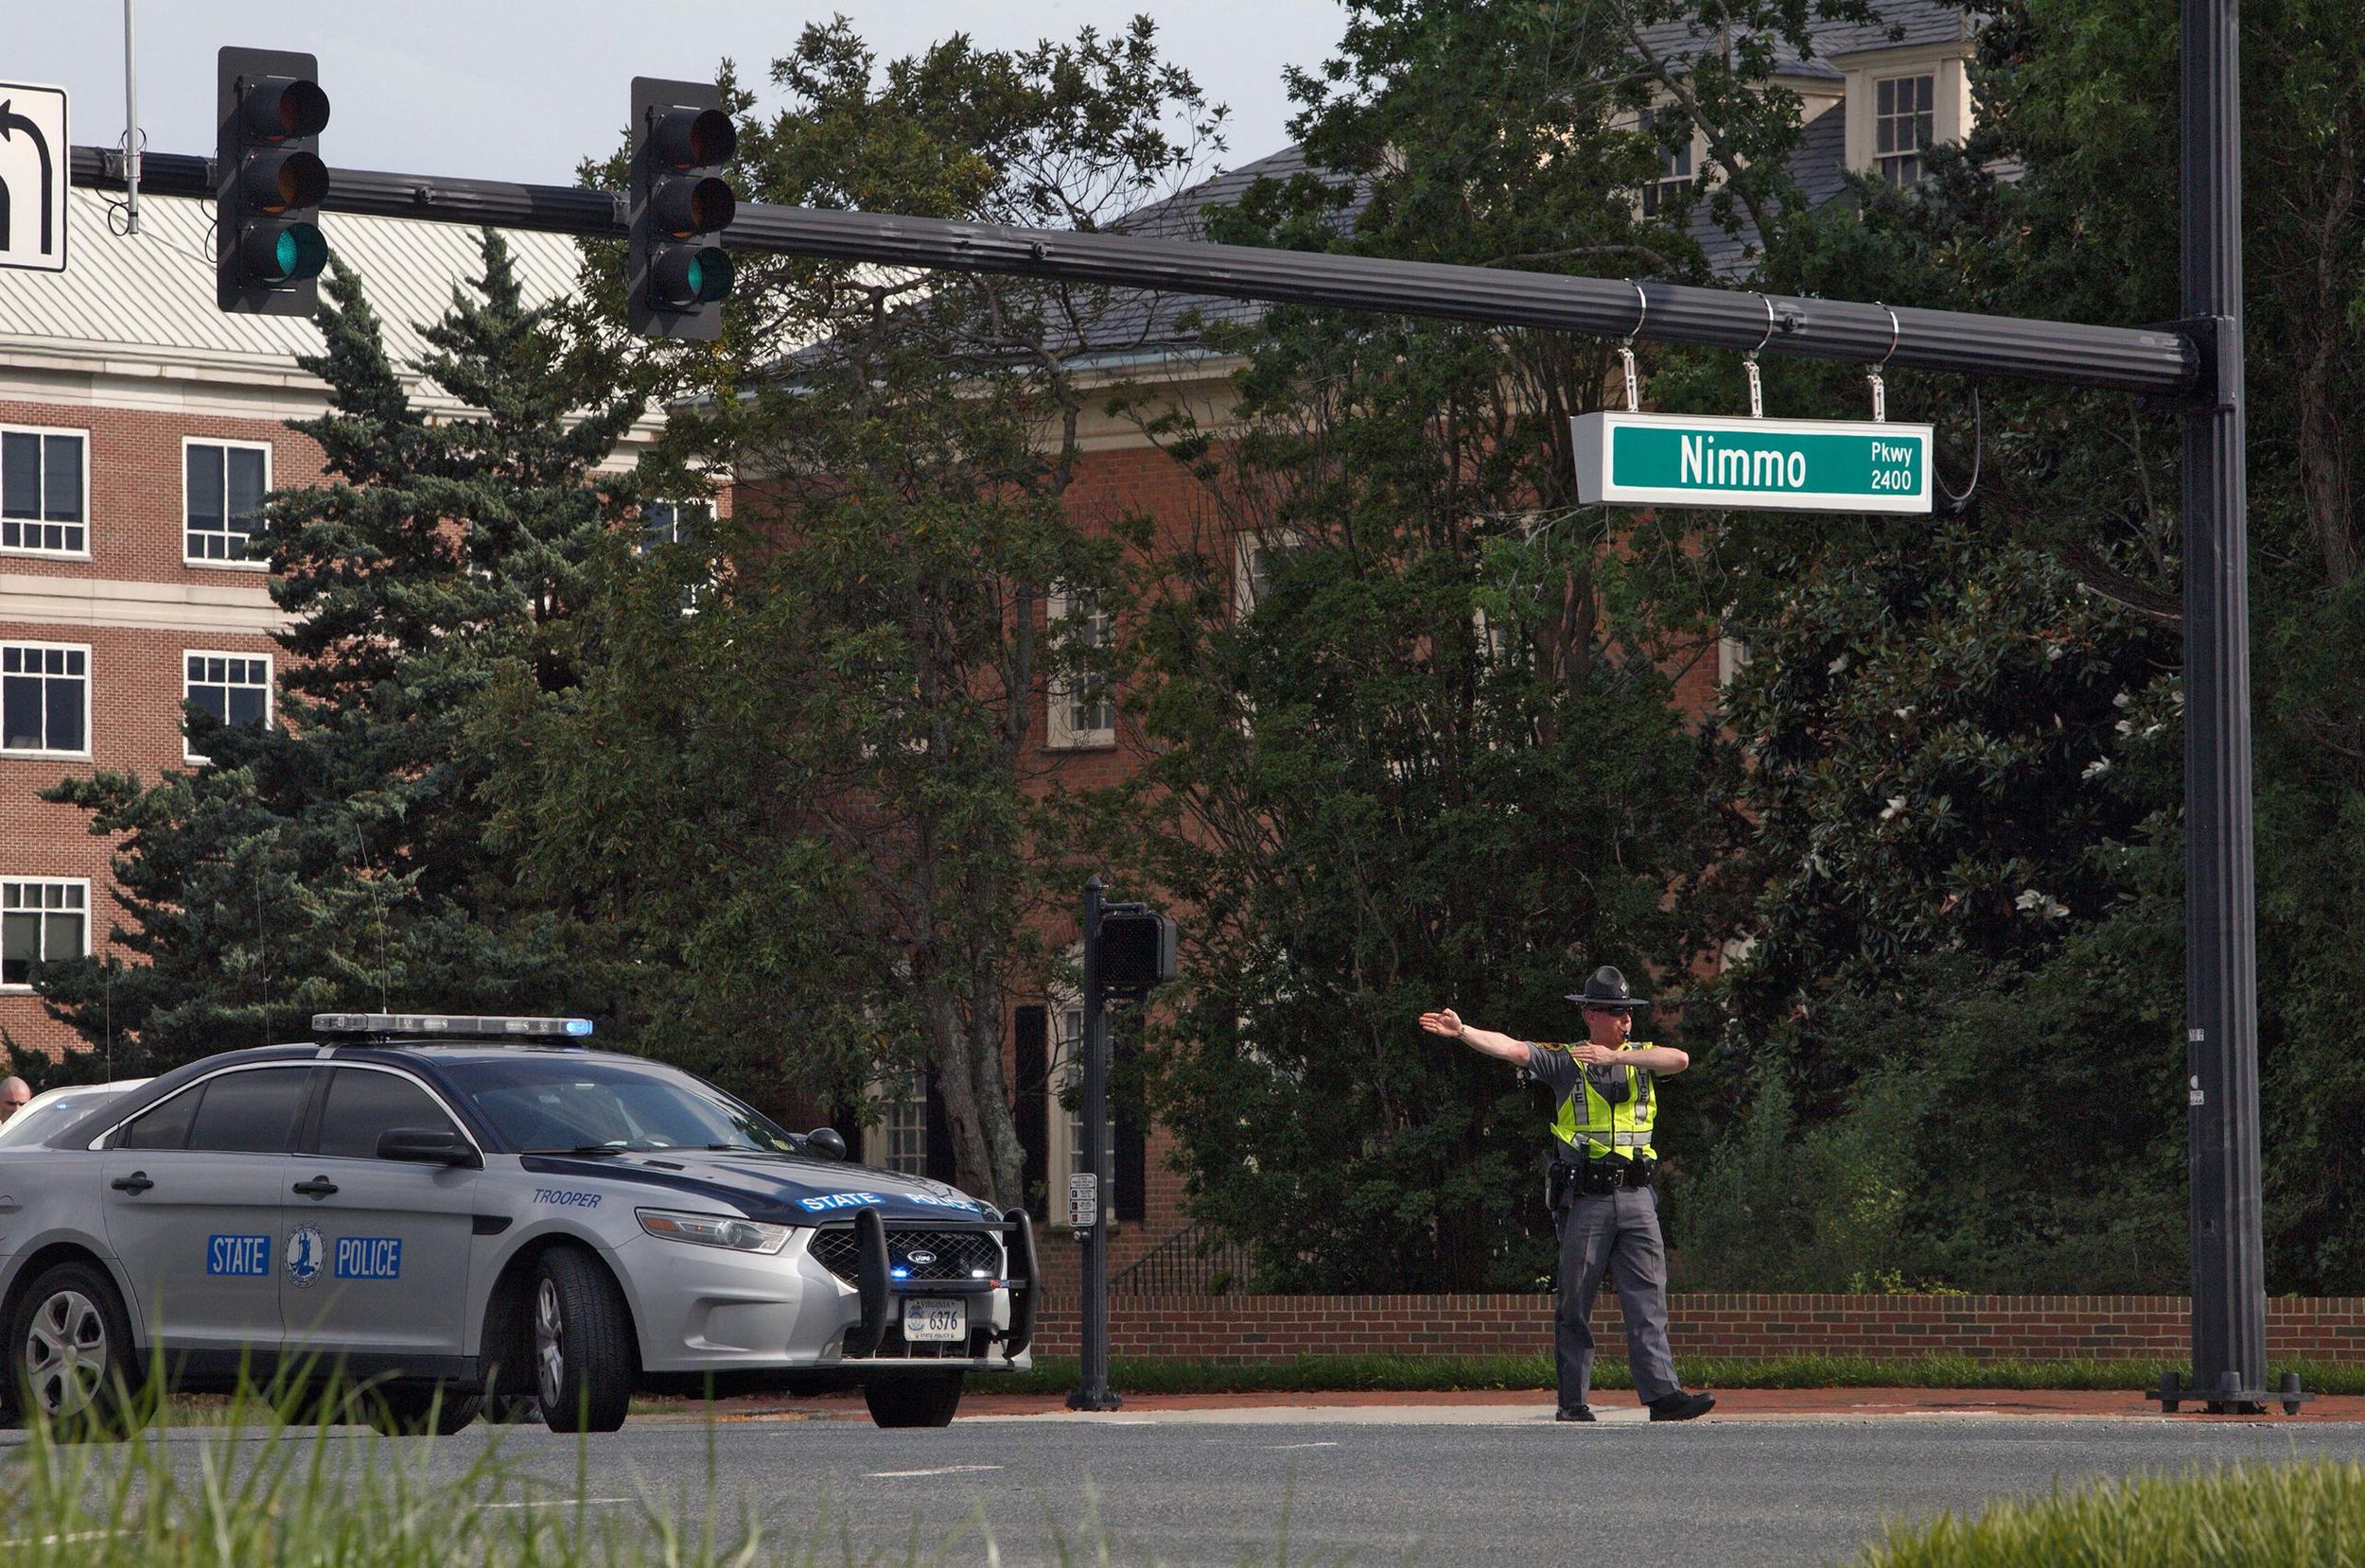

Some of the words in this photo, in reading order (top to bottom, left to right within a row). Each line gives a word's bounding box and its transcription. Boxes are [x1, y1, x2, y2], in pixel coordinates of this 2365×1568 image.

[1680, 434, 1806, 488] Nimmo
[1871, 442, 1913, 466] Pkwy
[1871, 469, 1912, 491] 2400
[1638, 1068, 1648, 1103] LICE
[533, 1188, 602, 1209] TROOPER
[801, 1192, 880, 1211] STATE
[902, 1193, 982, 1212] POLICE
[213, 1237, 265, 1273] STATE
[338, 1239, 398, 1277] POLICE
[930, 1311, 958, 1331] 6376
